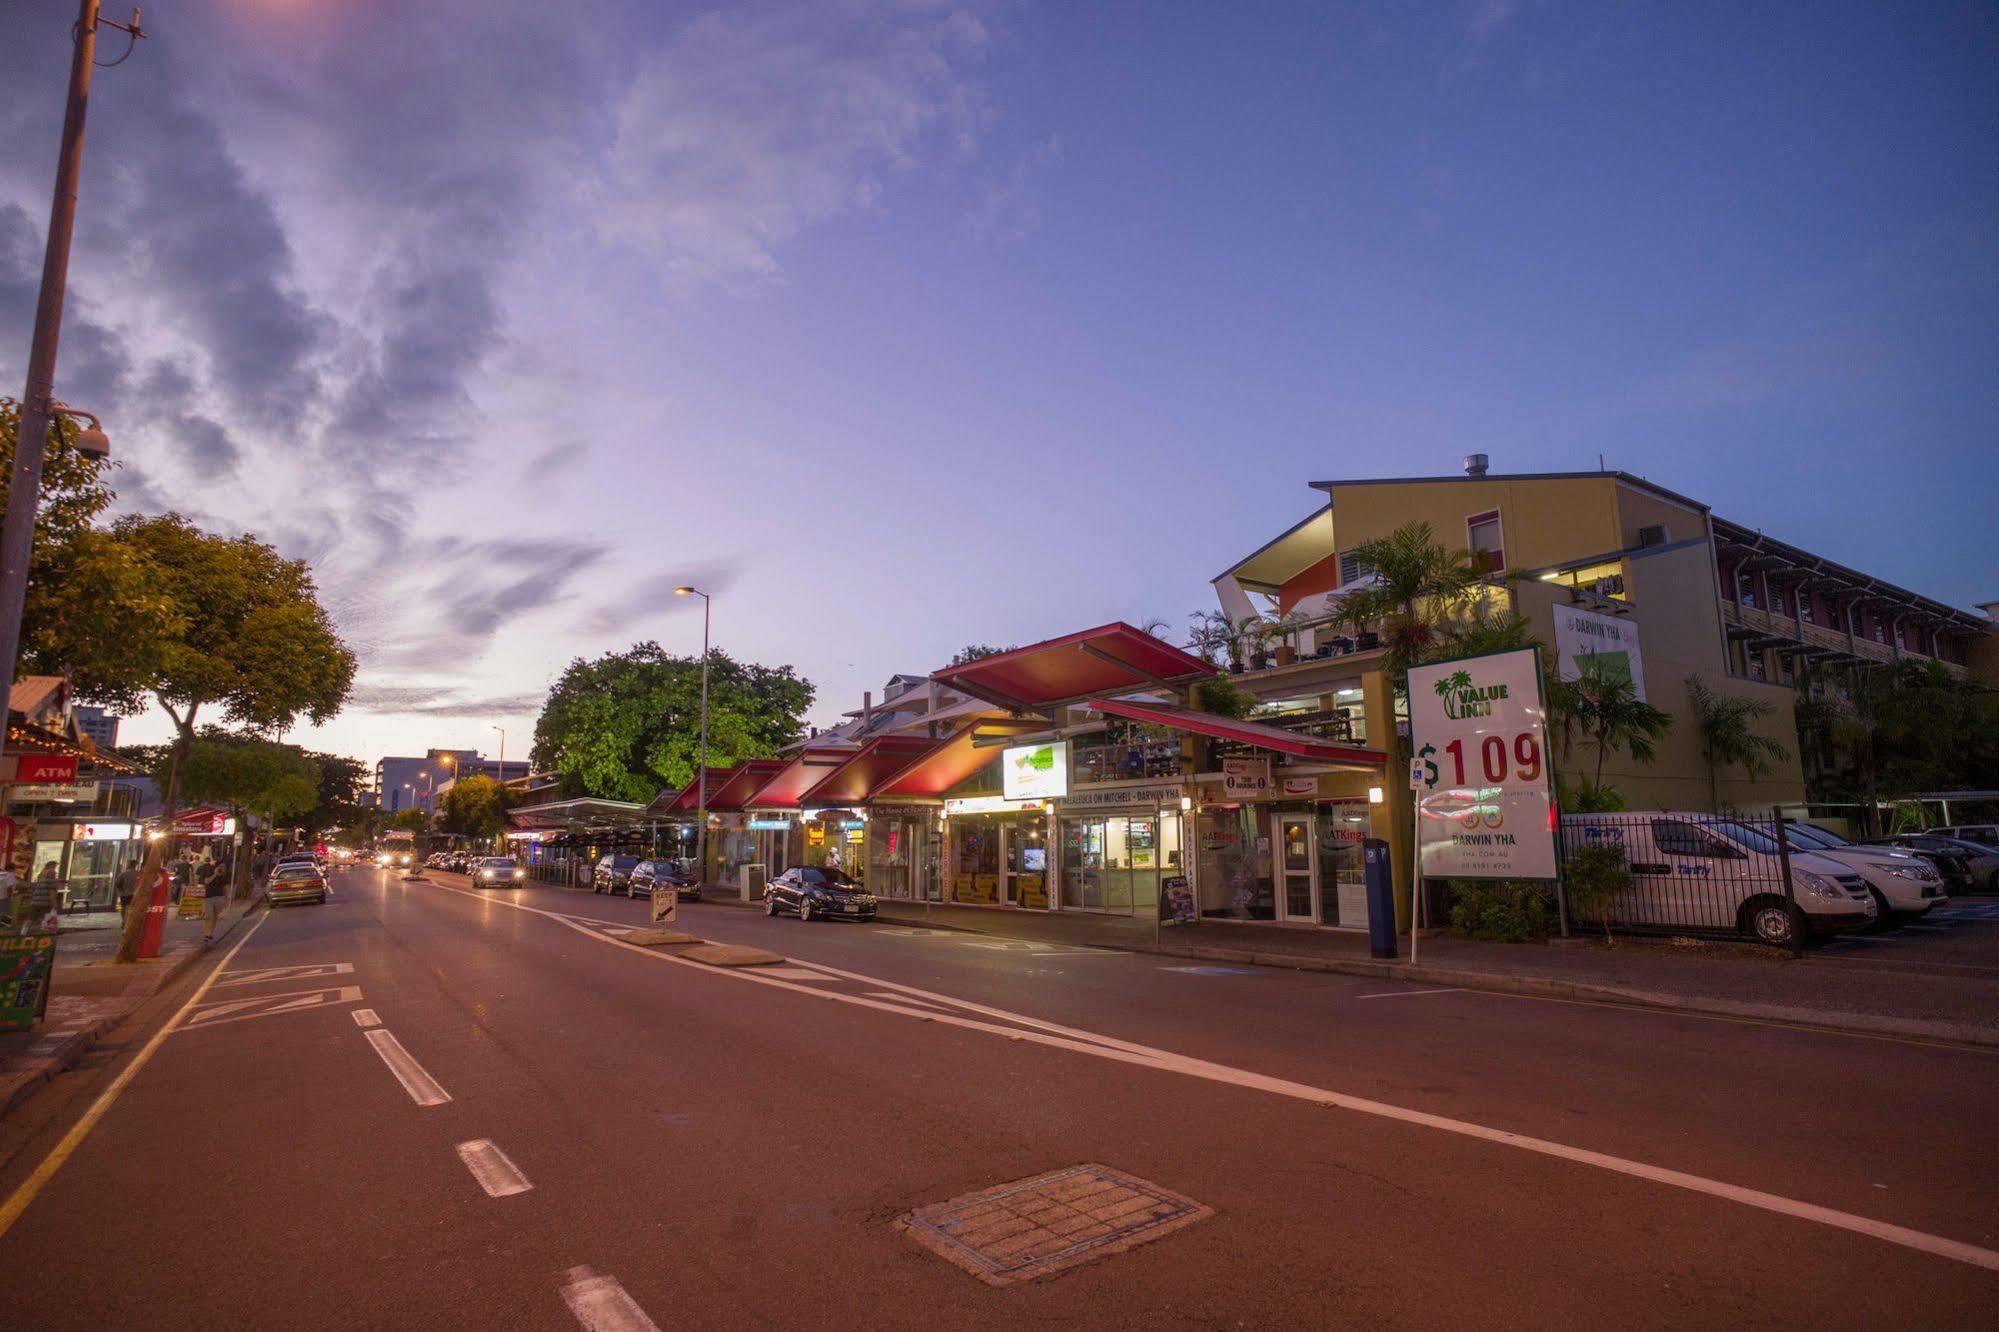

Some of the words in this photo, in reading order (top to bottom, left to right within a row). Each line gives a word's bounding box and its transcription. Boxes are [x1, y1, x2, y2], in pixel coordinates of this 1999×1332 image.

[1575, 618, 1605, 639] DARWIN
[1606, 624, 1621, 641] YHA
[1458, 684, 1509, 703] VALUE
[1460, 702, 1491, 719] INN
[33, 767, 72, 778] ATM
[1093, 793, 1103, 803] ON
[1104, 791, 1131, 802] MITCHELL
[1137, 789, 1164, 801] DARWIN
[1165, 788, 1180, 799] YHA
[1452, 834, 1492, 846] DARWIN
[1495, 834, 1516, 846] YHA
[1677, 864, 1711, 879] Thrifty
